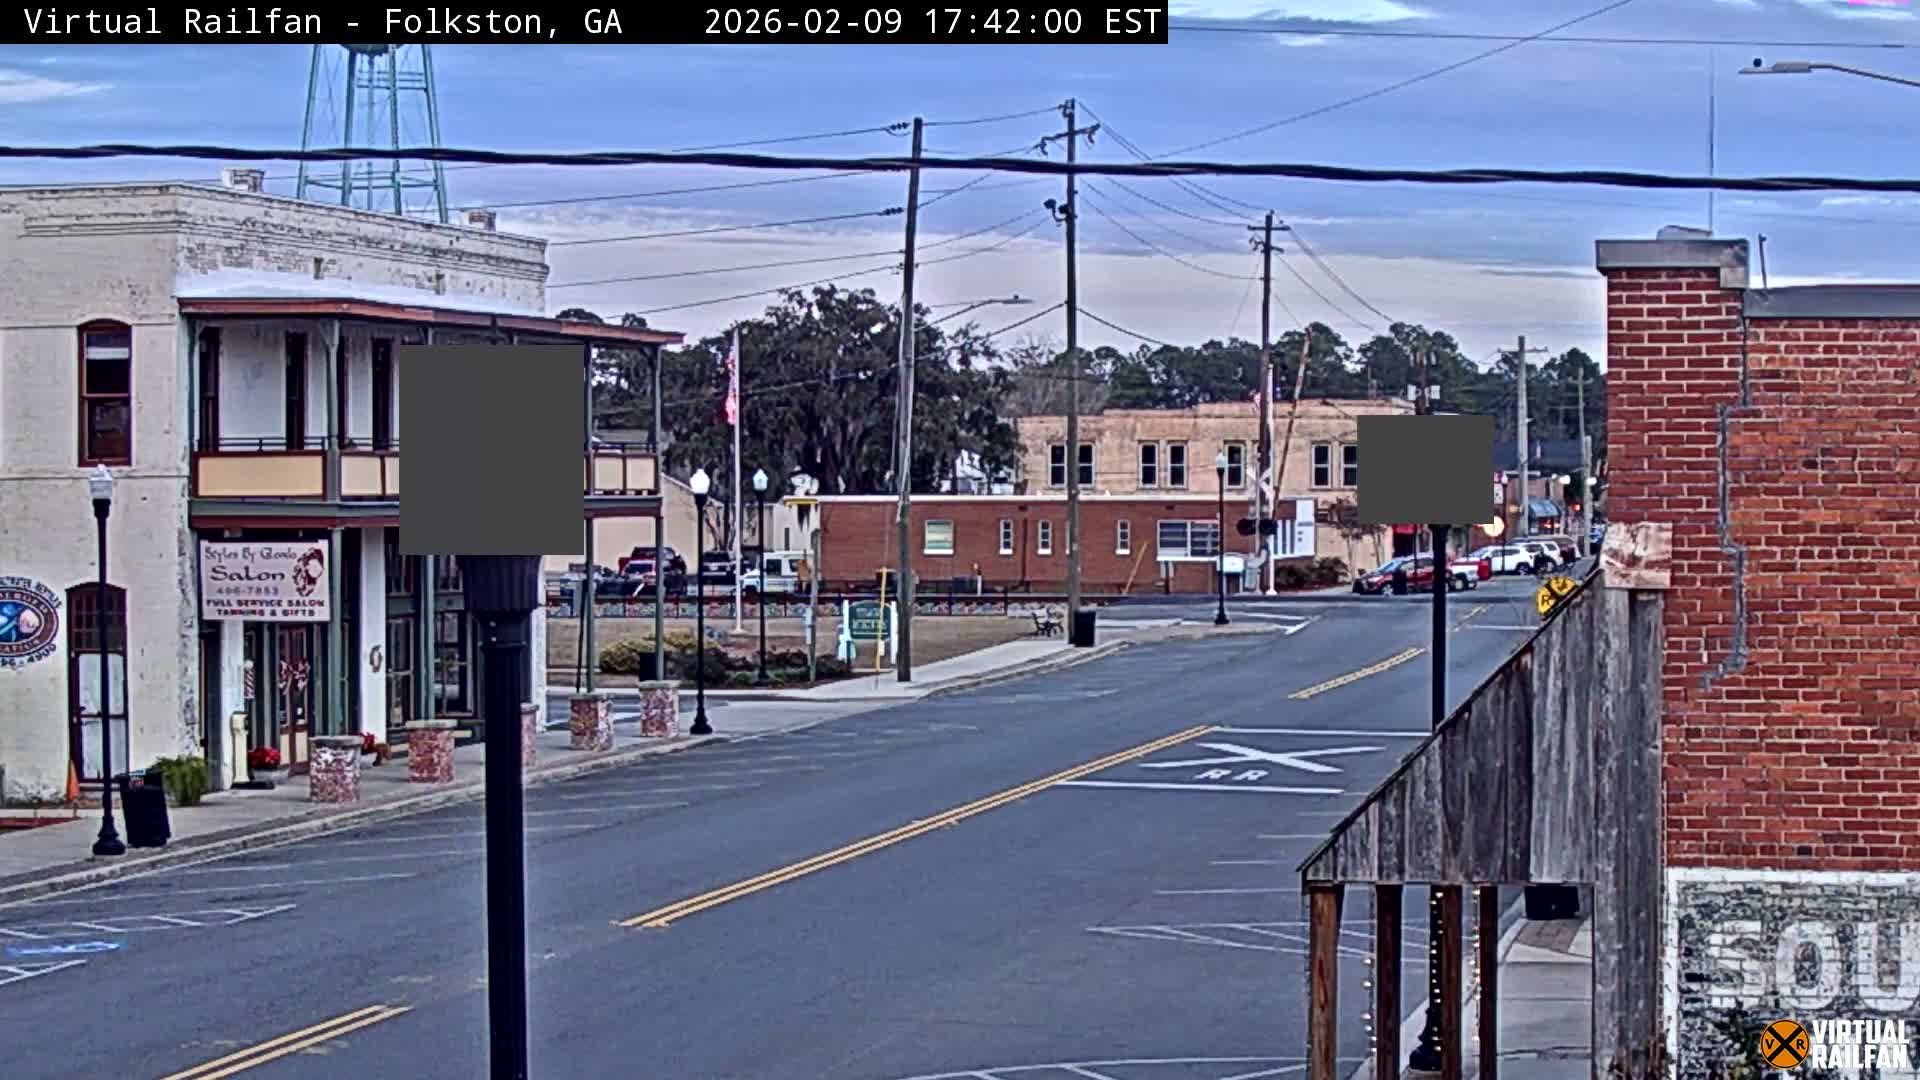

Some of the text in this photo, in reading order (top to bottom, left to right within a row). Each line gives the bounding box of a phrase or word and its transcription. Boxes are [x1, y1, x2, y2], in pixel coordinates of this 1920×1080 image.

[242, 546, 255, 563] By
[210, 565, 285, 581] Salon
[206, 599, 325, 607] FULL SERVICE SALON
[216, 609, 316, 617] TANNING & GIFTS
